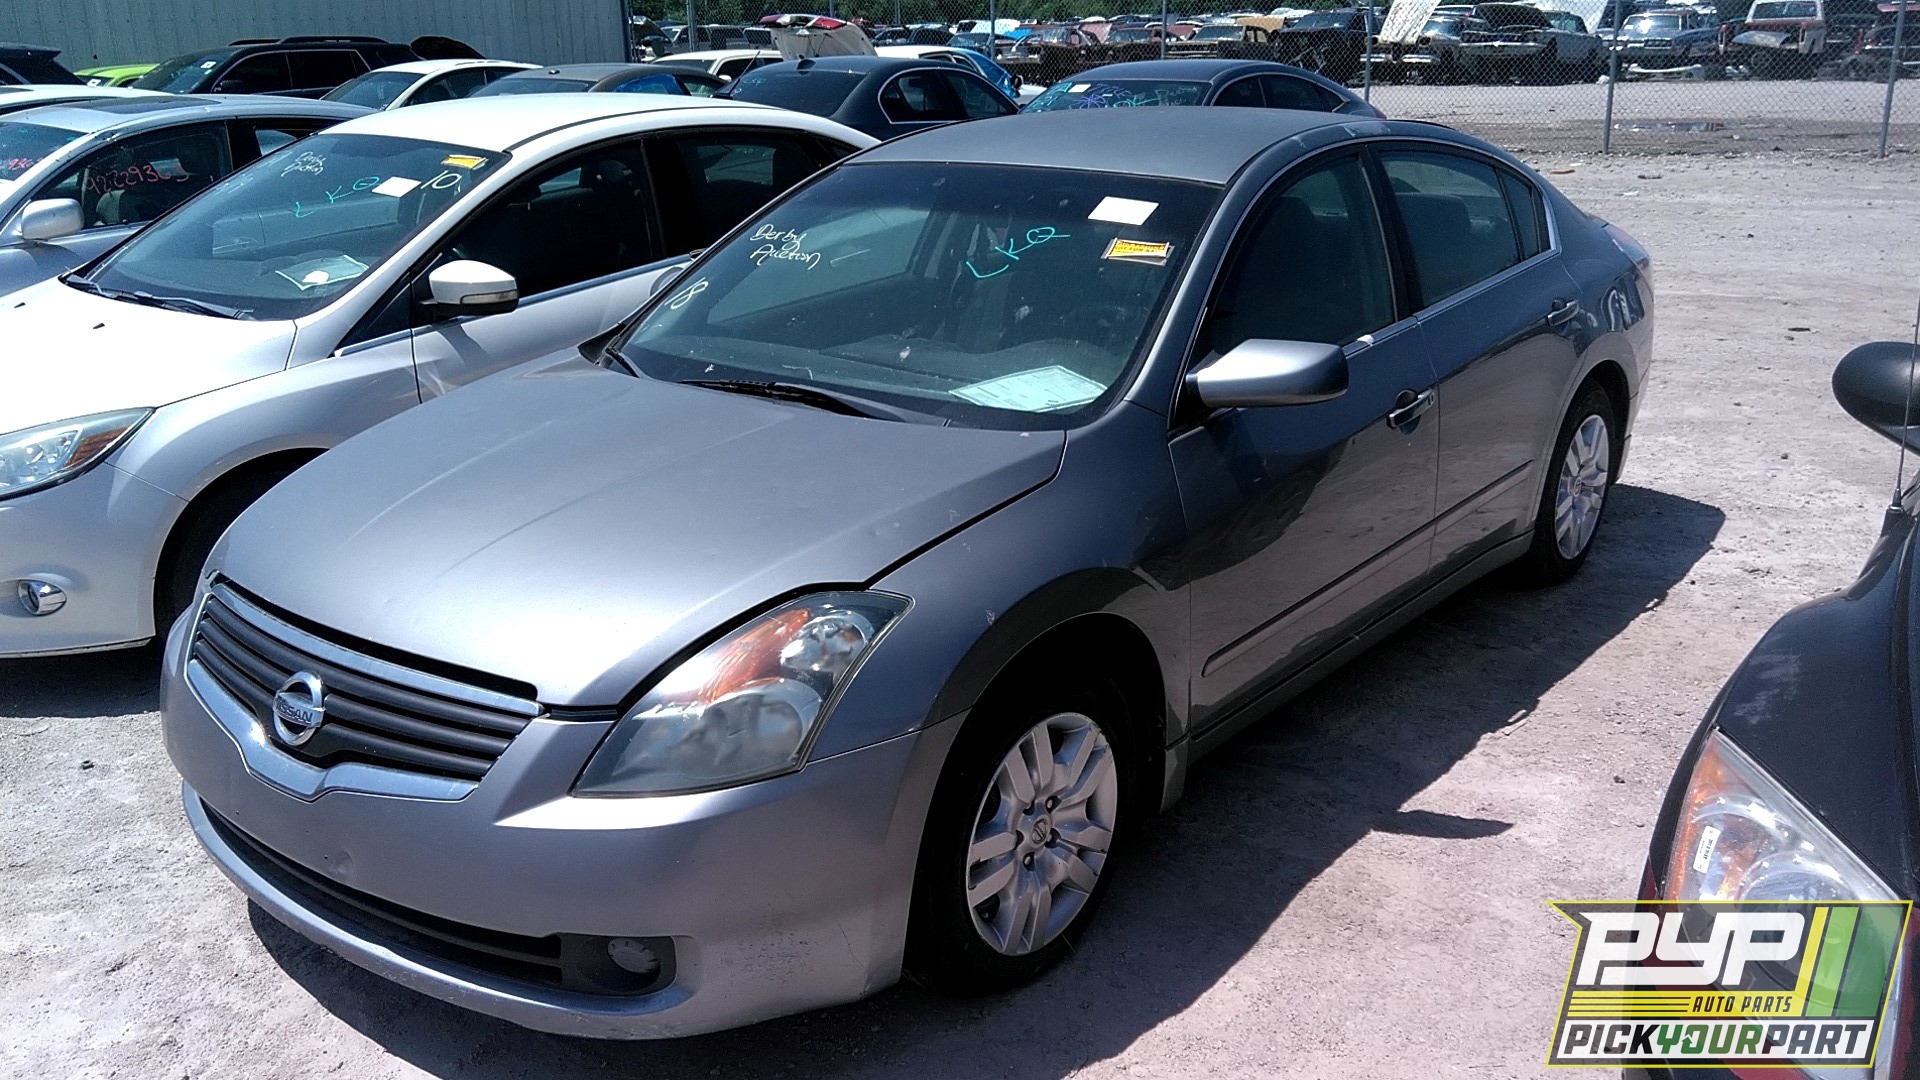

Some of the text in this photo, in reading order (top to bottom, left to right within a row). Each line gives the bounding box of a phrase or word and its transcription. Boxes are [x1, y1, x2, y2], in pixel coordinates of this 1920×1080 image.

[420, 169, 463, 190] 10
[750, 223, 808, 252] Derby
[965, 226, 1071, 279] LKQ
